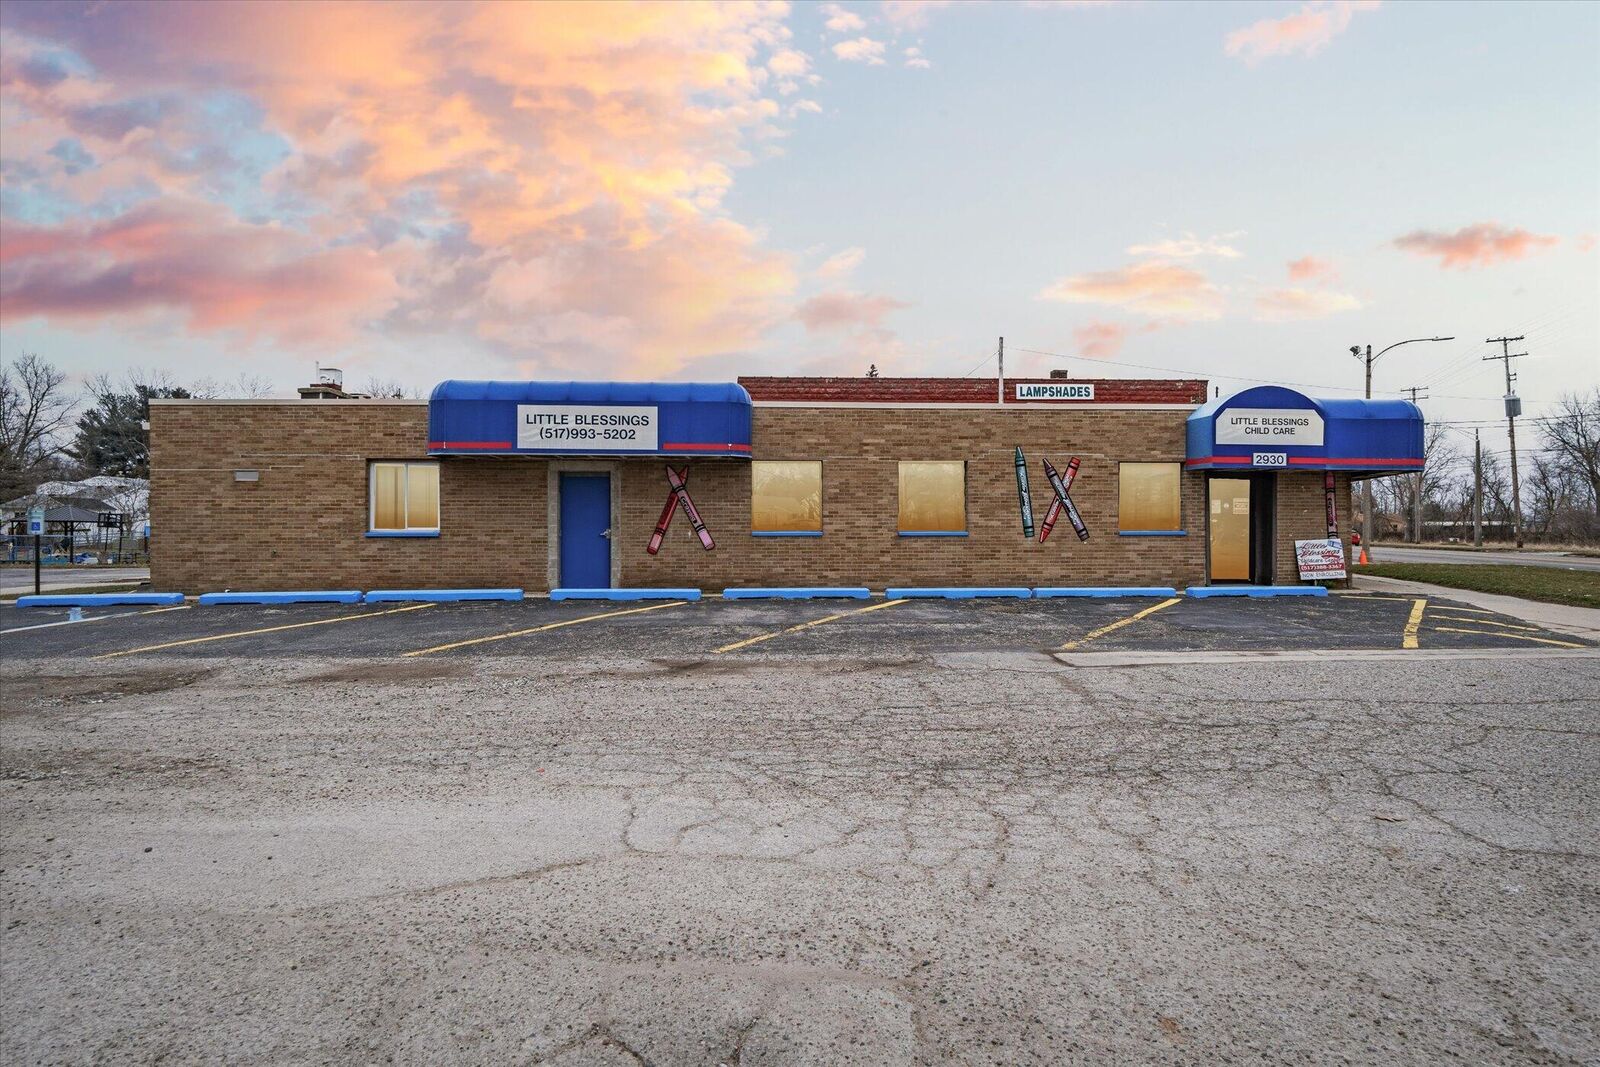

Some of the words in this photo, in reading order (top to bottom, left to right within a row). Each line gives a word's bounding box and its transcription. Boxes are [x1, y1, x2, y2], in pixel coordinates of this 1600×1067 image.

[1019, 386, 1091, 398] LAMPSHADES
[526, 413, 569, 425] LITTLE
[575, 414, 650, 426] BLESSINGS
[1230, 417, 1258, 425] LITTLE
[1261, 417, 1309, 426] BLESSINGS
[539, 426, 636, 440] (517)993-5202
[1244, 426, 1270, 435] CHILD
[1272, 427, 1296, 435] CARE
[1255, 454, 1284, 465] 2930
